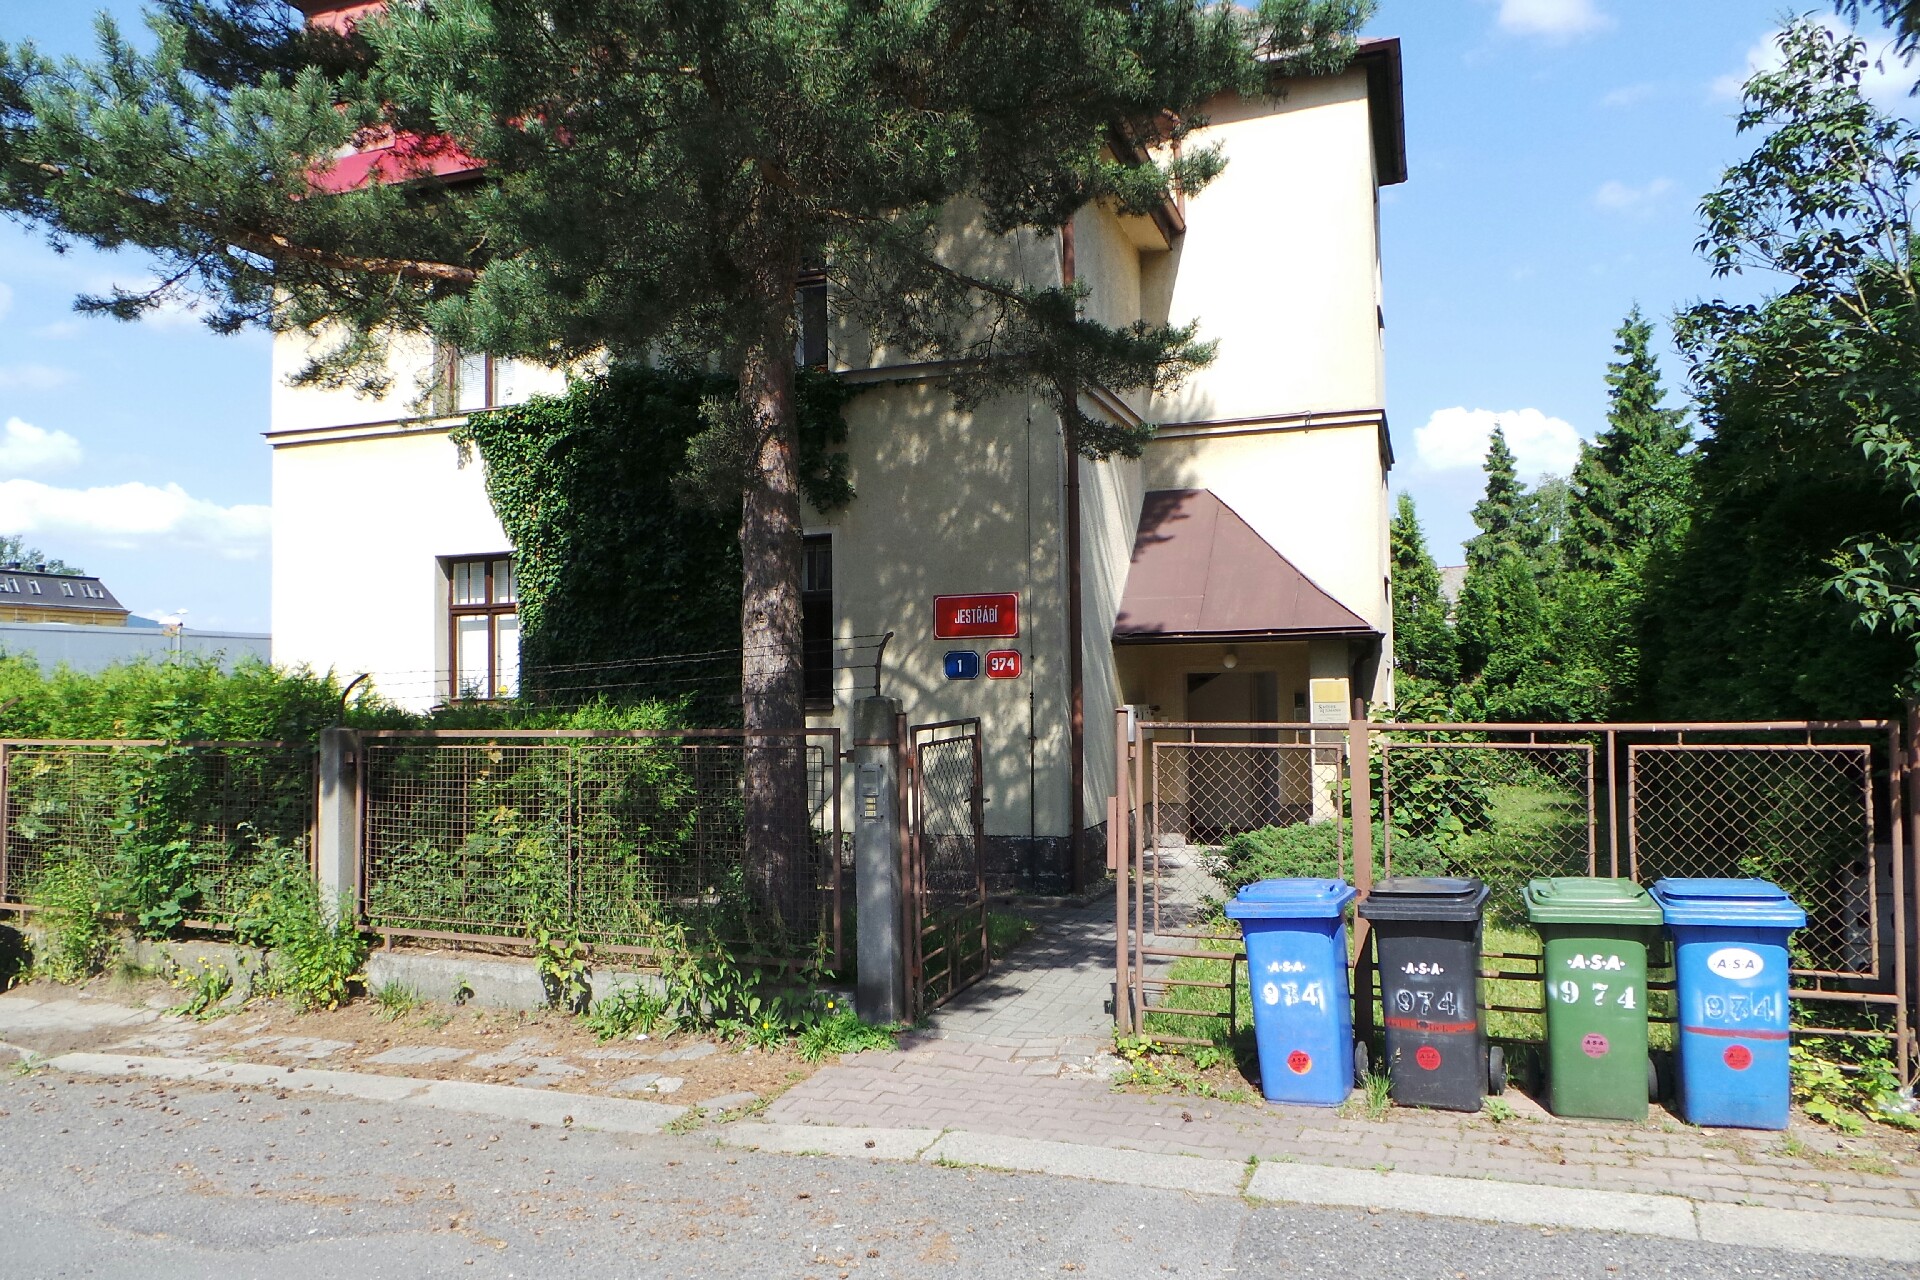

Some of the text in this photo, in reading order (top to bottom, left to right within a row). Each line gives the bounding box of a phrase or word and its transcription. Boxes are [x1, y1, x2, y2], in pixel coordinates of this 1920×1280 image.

[954, 604, 999, 624] JESTŘÁBÍ
[957, 659, 962, 673] 1
[991, 657, 1015, 671] 974
[1396, 989, 1456, 1016] 974
